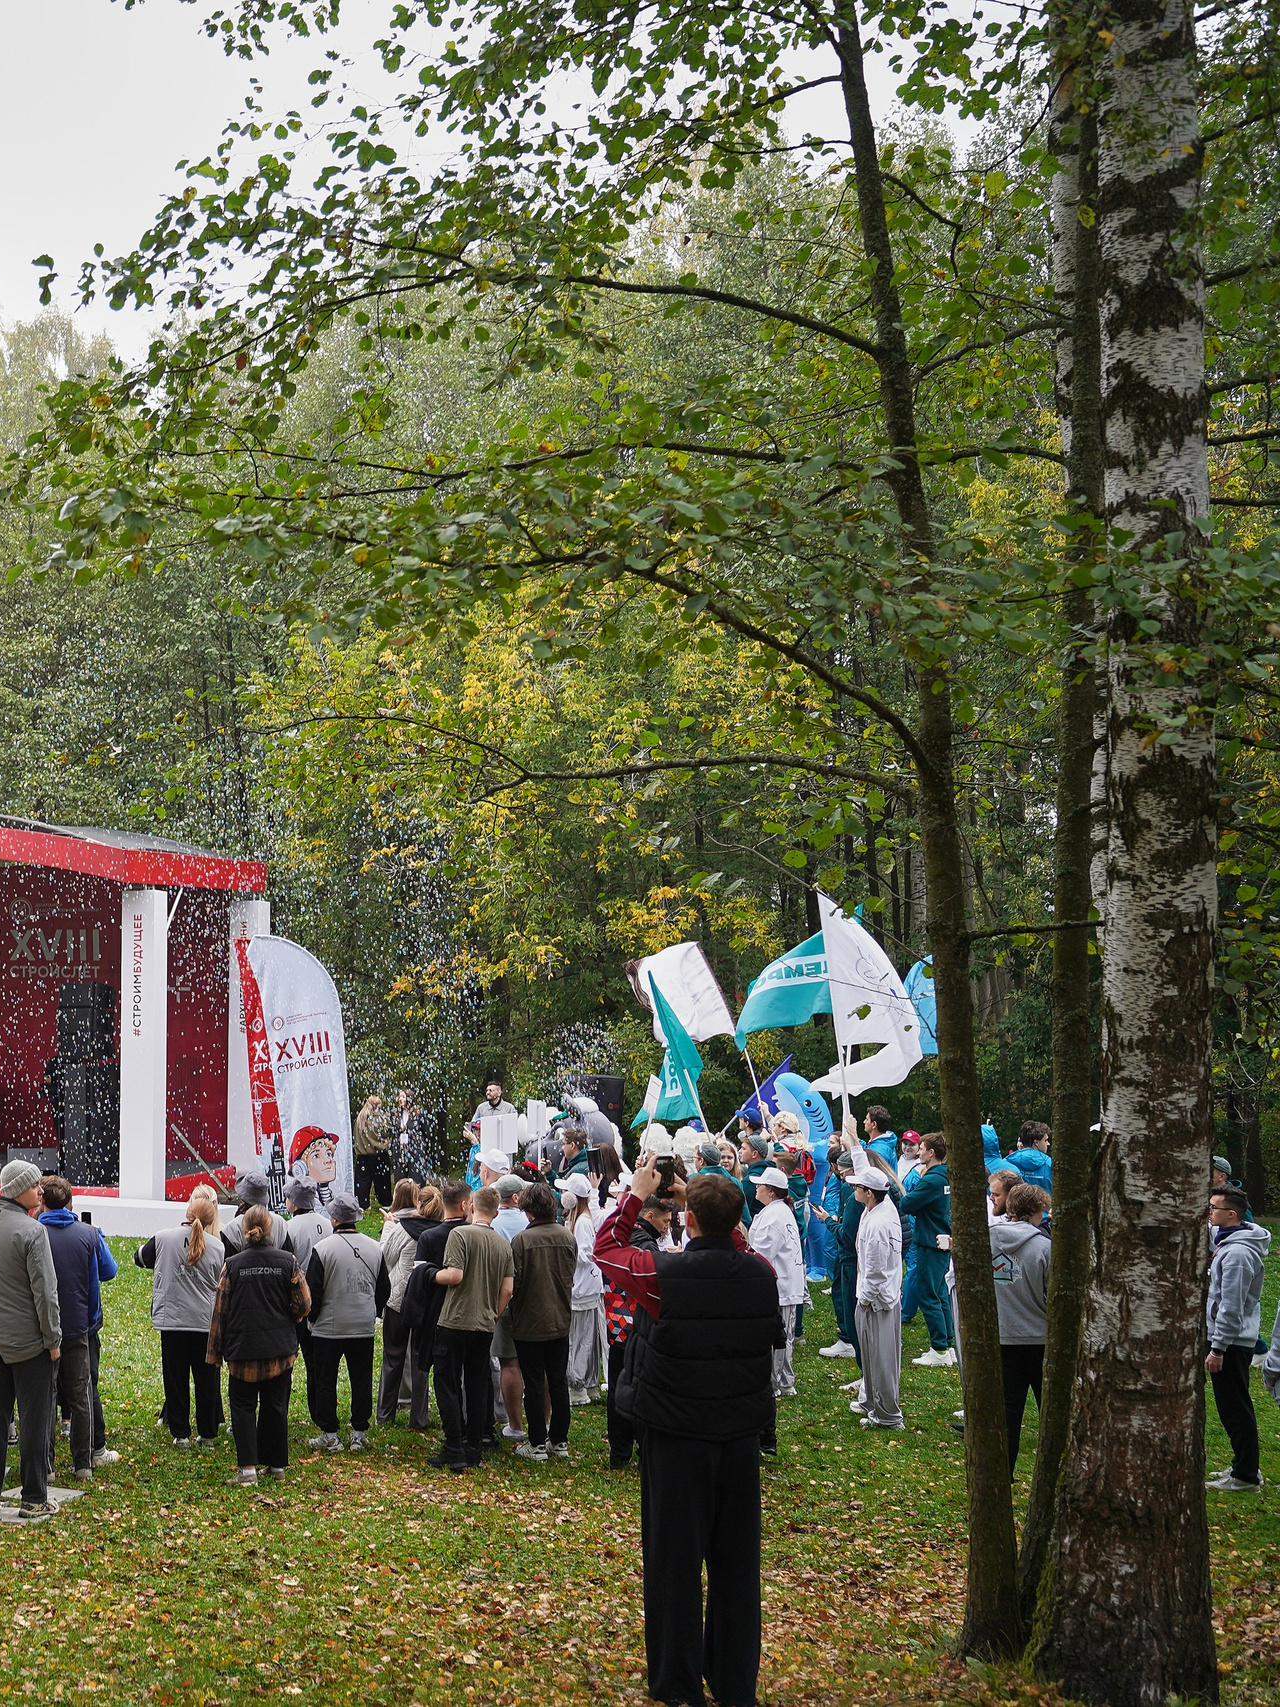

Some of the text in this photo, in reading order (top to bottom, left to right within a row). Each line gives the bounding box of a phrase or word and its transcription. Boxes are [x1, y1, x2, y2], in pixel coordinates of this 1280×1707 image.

[10, 930, 100, 961] XVIII
[133, 914, 143, 1036] #СТРОИМБУДУЩЕЕ
[275, 1031, 330, 1062] XVIII
[277, 1054, 332, 1074] СТРОЙСЛЁТ
[240, 1267, 282, 1276] BEEZONE
